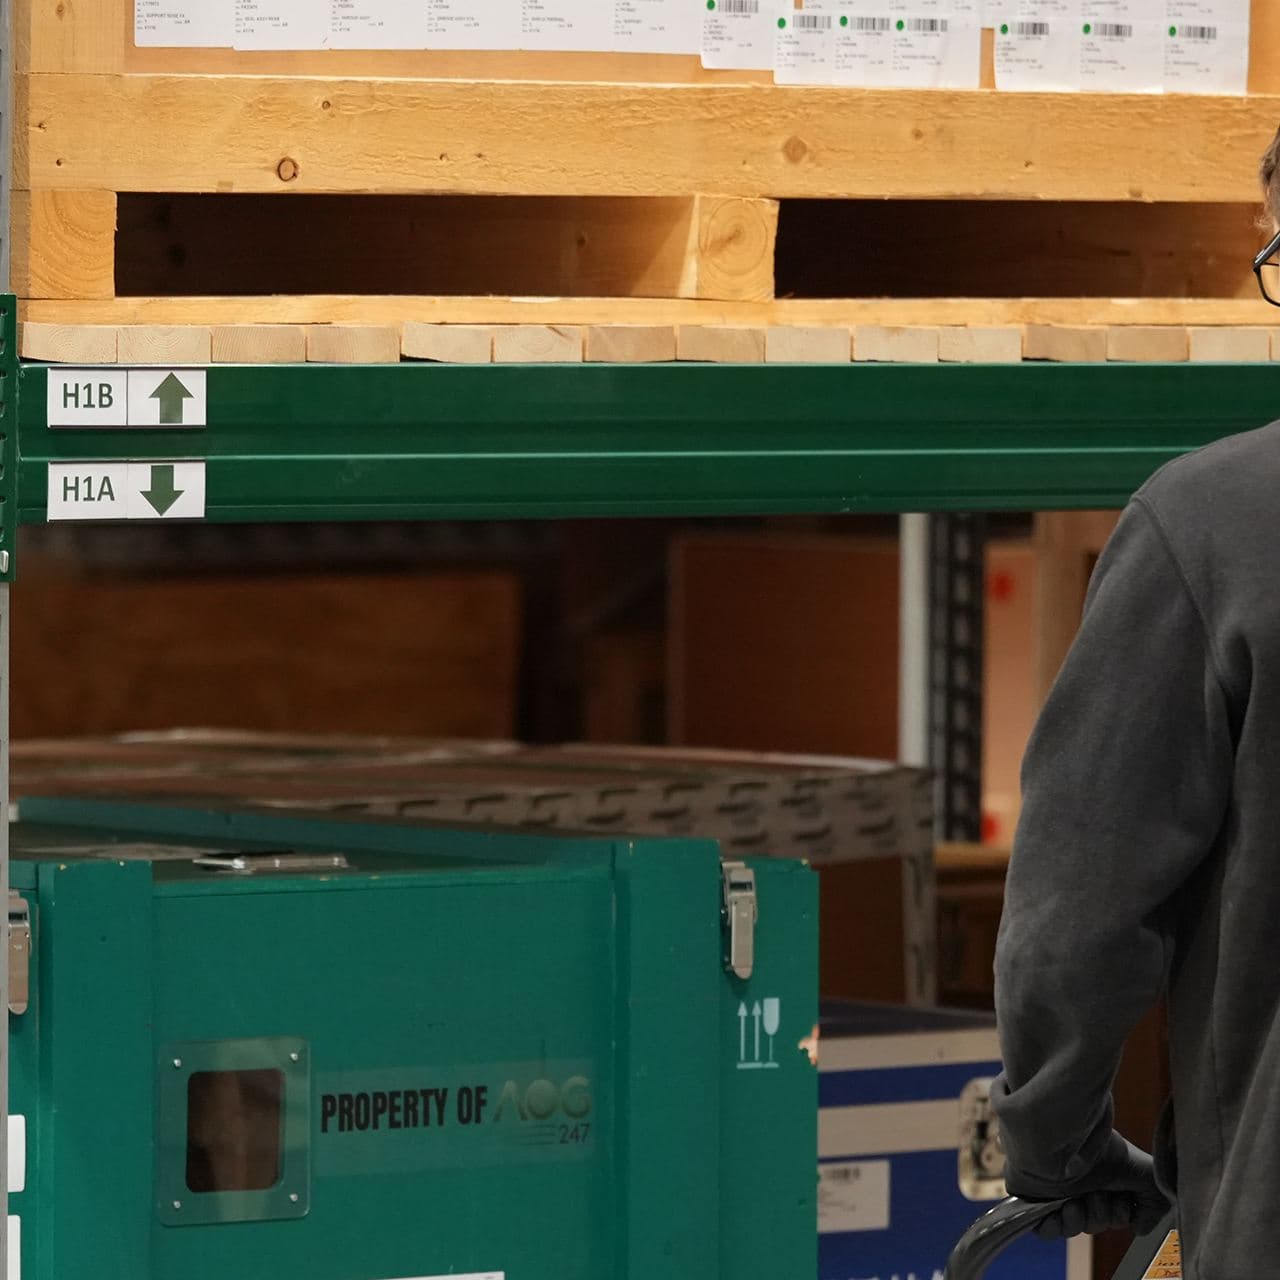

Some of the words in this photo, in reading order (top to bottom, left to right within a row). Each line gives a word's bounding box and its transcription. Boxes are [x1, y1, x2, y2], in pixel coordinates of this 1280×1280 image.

[63, 382, 114, 409] H1B
[63, 476, 116, 502] H1A
[321, 1088, 448, 1134] PROPERTY
[457, 1086, 488, 1125] OF
[493, 1075, 592, 1123] AOG
[559, 1123, 591, 1144] 247
